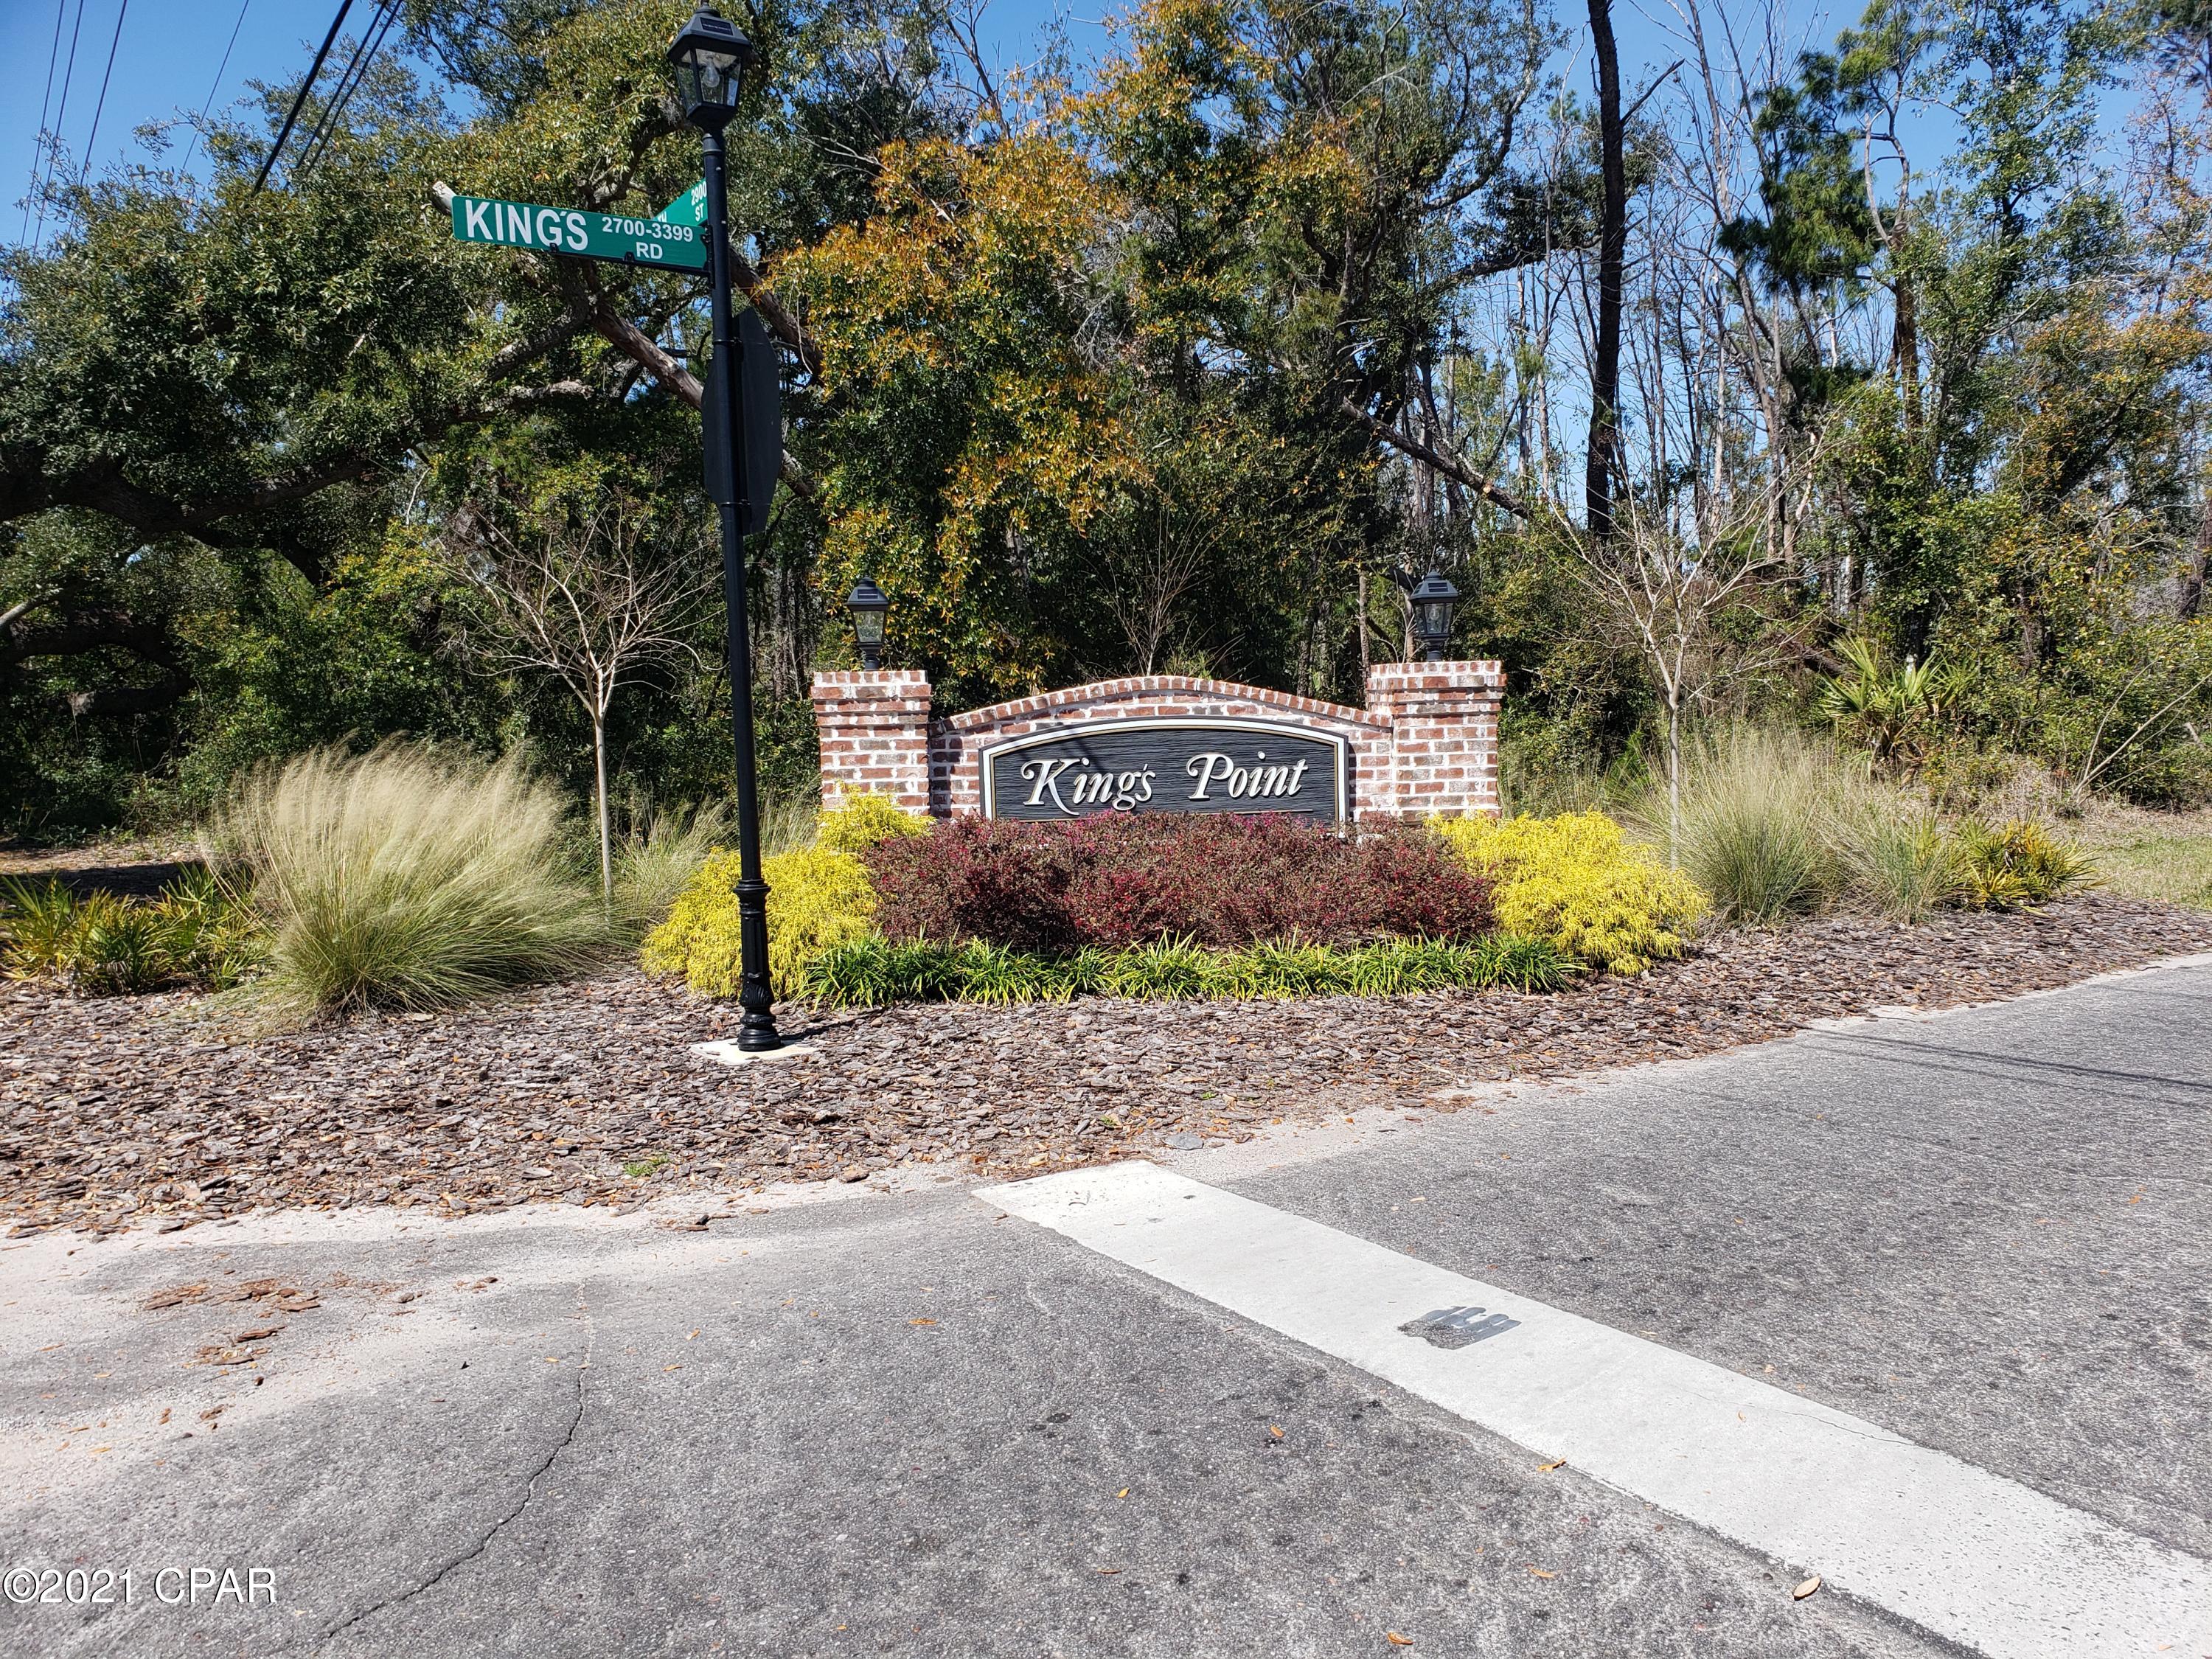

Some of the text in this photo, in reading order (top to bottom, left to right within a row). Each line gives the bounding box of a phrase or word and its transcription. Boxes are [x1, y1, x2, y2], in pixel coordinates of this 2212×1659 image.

[691, 181, 707, 206] 2900
[465, 199, 694, 251] KING'S 2700-3399
[695, 203, 704, 222] ST
[636, 242, 664, 260] RD
[1020, 751, 1309, 816] King's Point
